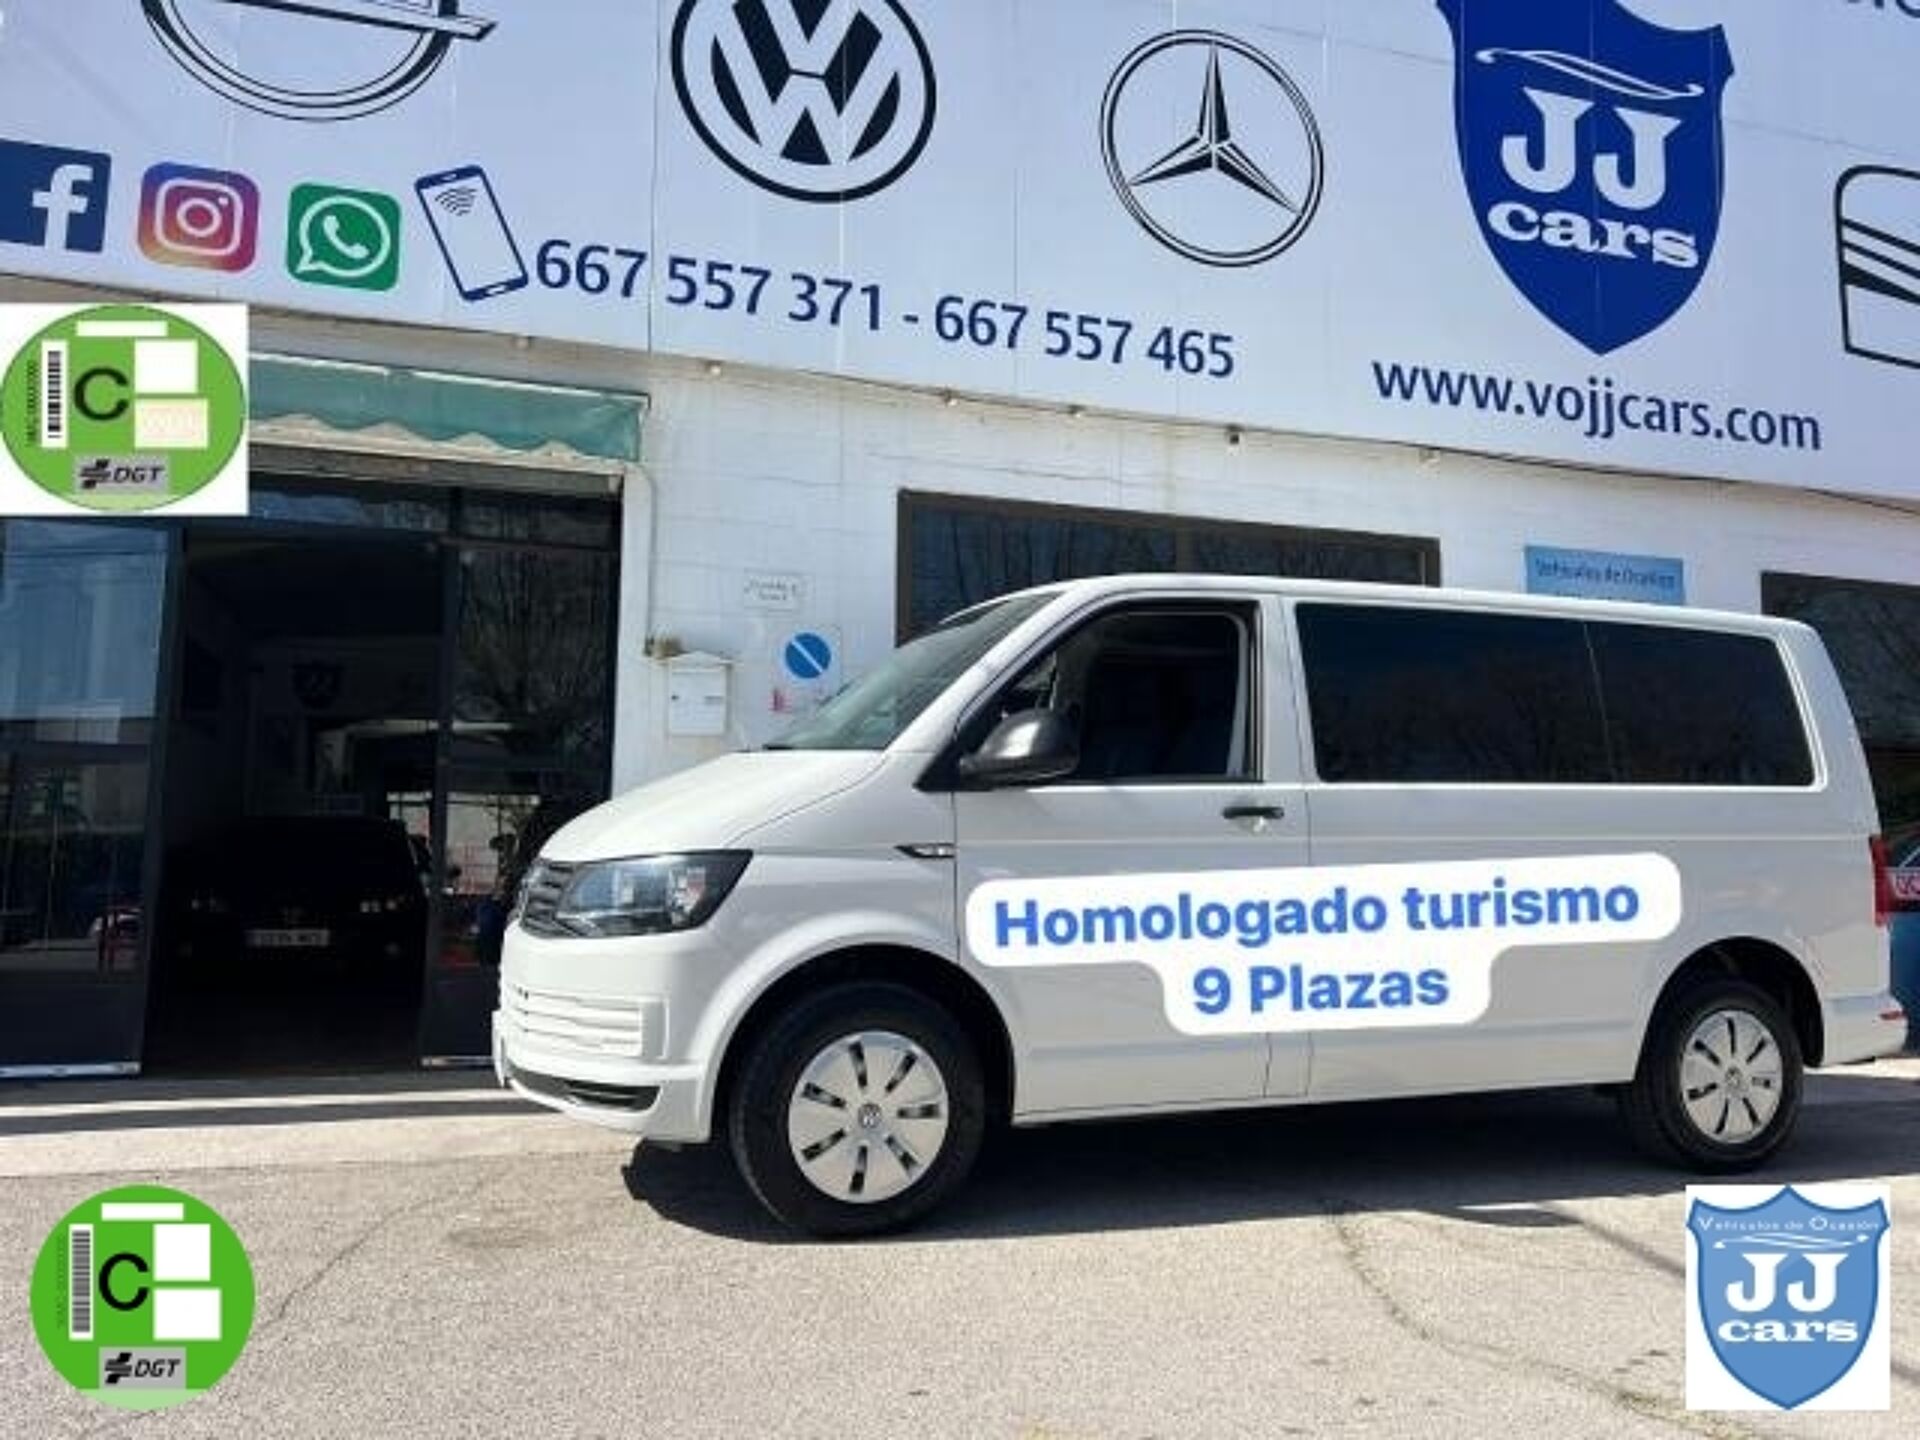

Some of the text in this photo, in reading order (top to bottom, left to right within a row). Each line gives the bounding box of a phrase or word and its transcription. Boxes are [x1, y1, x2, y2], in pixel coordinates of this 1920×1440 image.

[1502, 87, 1682, 209] JJ
[1488, 203, 1699, 269] cars
[536, 238, 648, 299] 667
[665, 255, 772, 316] 557
[788, 272, 881, 331] 371
[934, 295, 1029, 350] 667
[1045, 310, 1133, 364] 557
[1146, 326, 1234, 379] 465
[1372, 361, 1822, 452] www.vojjcars.com
